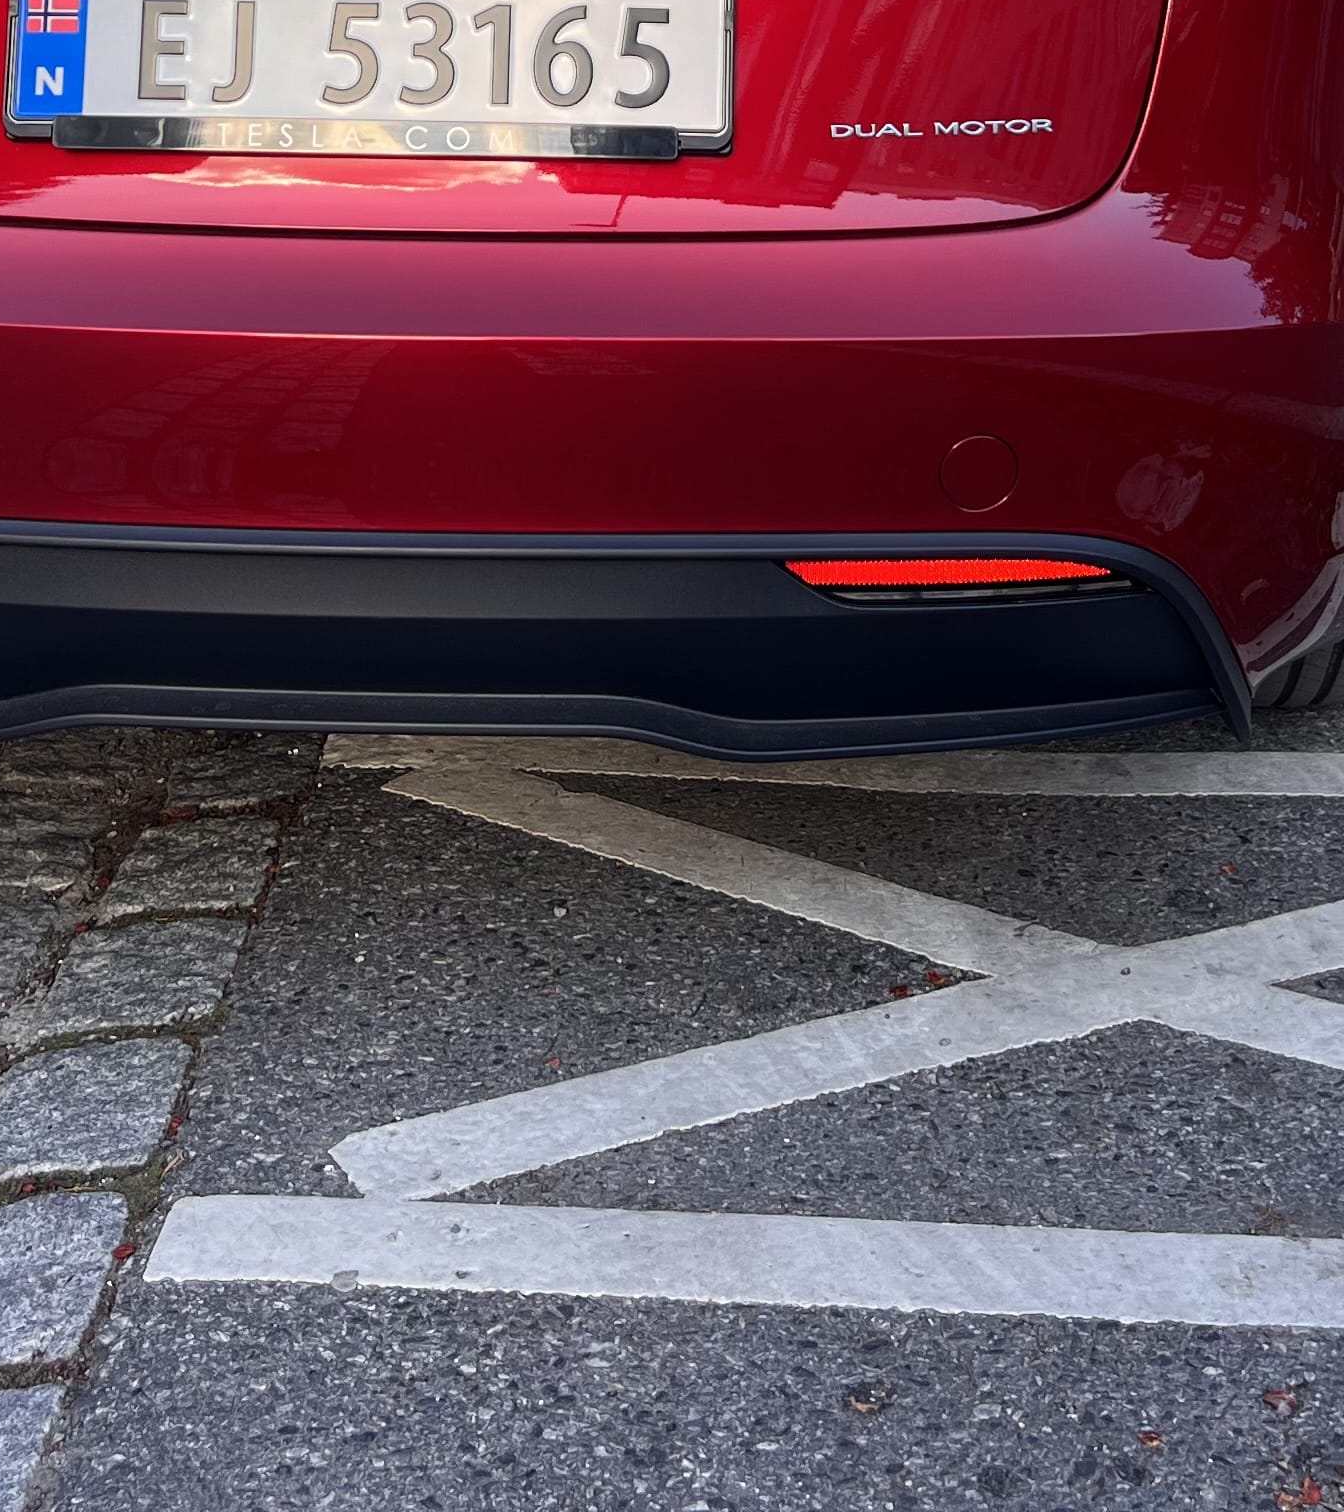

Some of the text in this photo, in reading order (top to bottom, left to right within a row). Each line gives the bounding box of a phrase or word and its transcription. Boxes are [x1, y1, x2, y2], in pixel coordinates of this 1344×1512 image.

[138, 0, 671, 109] EJ 53165
[34, 66, 65, 97] N
[830, 119, 1053, 138] DUAL MOTOR
